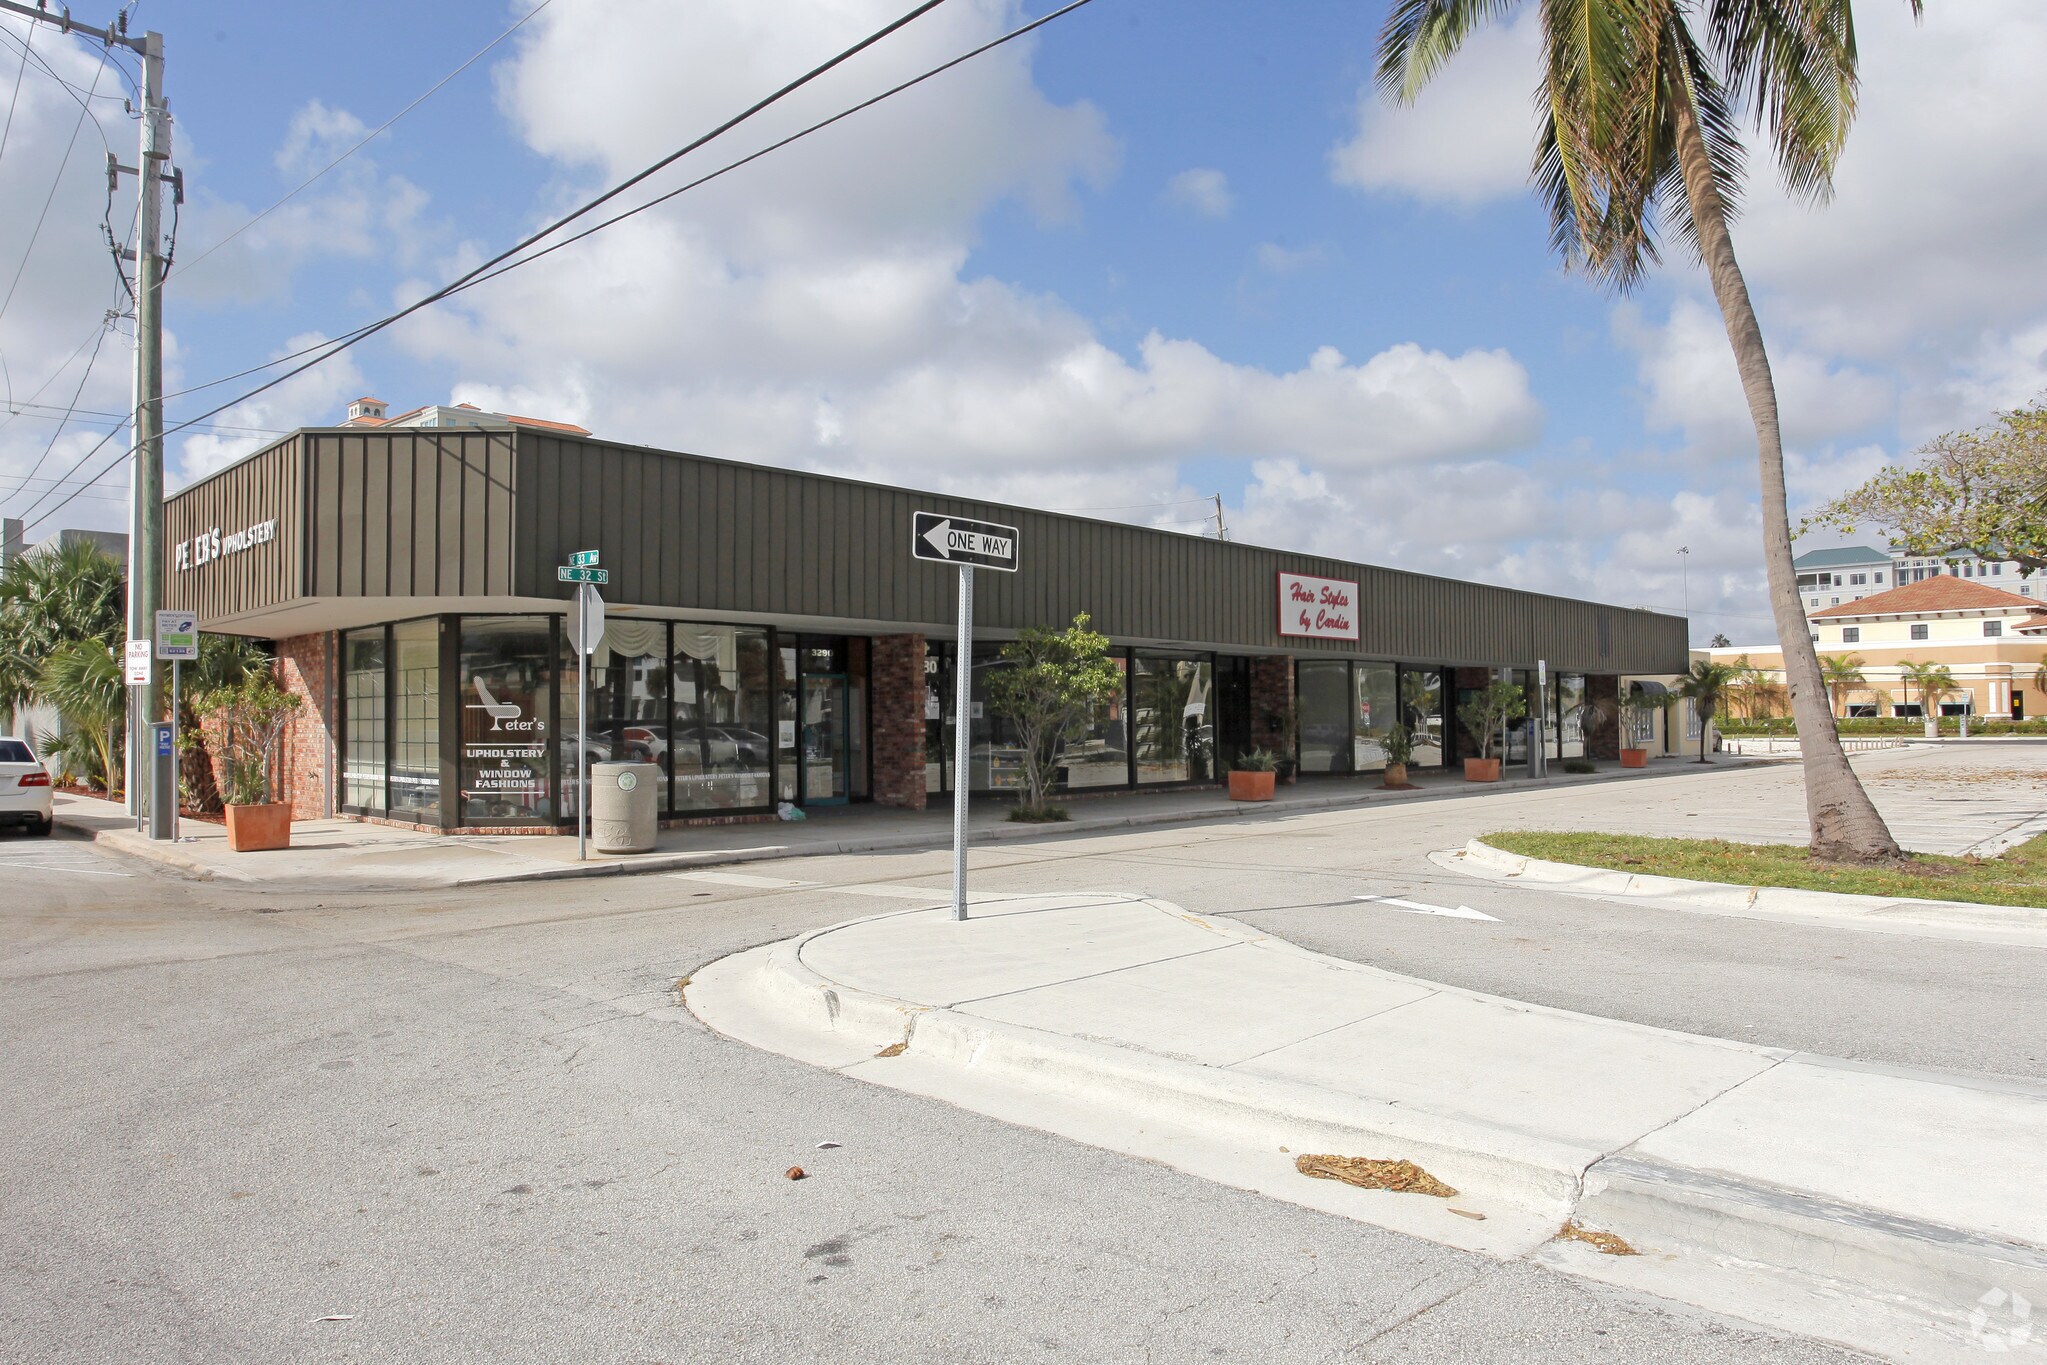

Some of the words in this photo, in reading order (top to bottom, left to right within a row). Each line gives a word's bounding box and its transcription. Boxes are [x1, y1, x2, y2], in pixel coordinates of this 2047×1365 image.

[176, 525, 221, 572] PEER'S
[223, 518, 278, 556] UPHOLSTERY
[947, 531, 975, 551] ONE
[982, 536, 1008, 555] WAY
[577, 553, 586, 565] 33
[560, 568, 573, 580] NE
[580, 569, 592, 581] 32
[597, 571, 606, 582] St
[1290, 582, 1316, 603] Hair
[1319, 585, 1349, 610] Styles
[1299, 608, 1311, 632] by
[1315, 608, 1350, 630] Cardin
[128, 650, 149, 658] PARKING
[811, 648, 833, 657] 3290
[160, 730, 170, 742] P
[466, 749, 545, 758] UPHOLSTERY
[500, 759, 510, 768] &
[479, 769, 532, 778] WINDOW
[475, 779, 536, 788] FASHIONS
